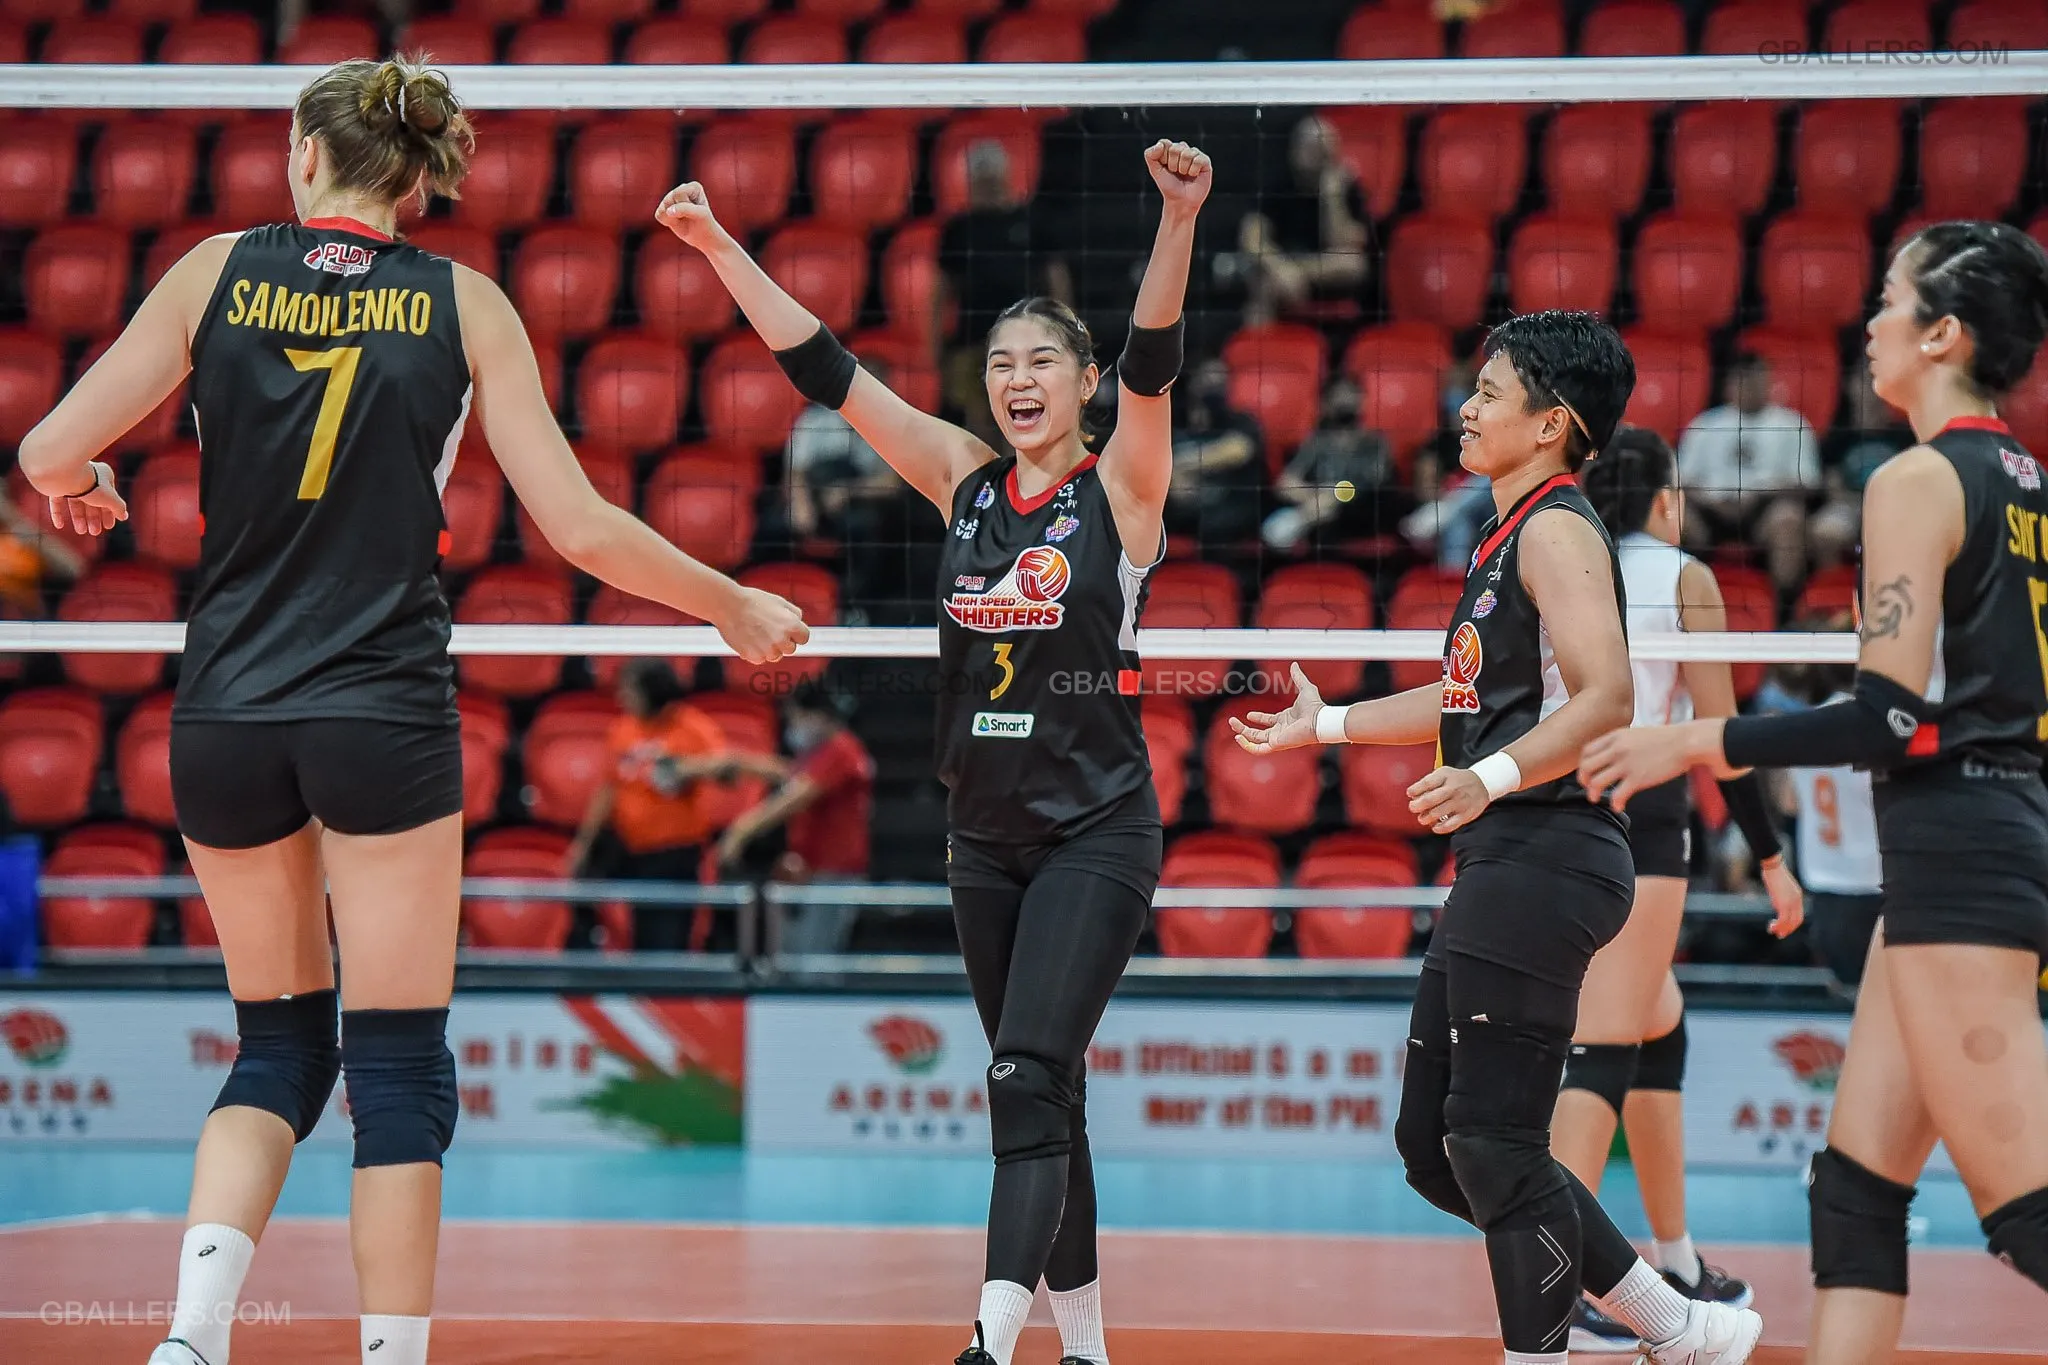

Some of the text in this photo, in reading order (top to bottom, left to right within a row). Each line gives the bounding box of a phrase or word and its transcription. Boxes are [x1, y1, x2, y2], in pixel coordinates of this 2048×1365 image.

[324, 244, 376, 265] PLDT
[227, 279, 432, 337] SAMOILENKO
[283, 346, 363, 500] 7
[963, 576, 986, 586] PLDT
[953, 596, 1016, 607] HIGH SPEED
[962, 607, 1060, 627] HITTERS
[990, 643, 1014, 700] 3
[1442, 687, 1480, 709] ERS
[991, 718, 1027, 732] Smart
[1813, 775, 1843, 847] 9
